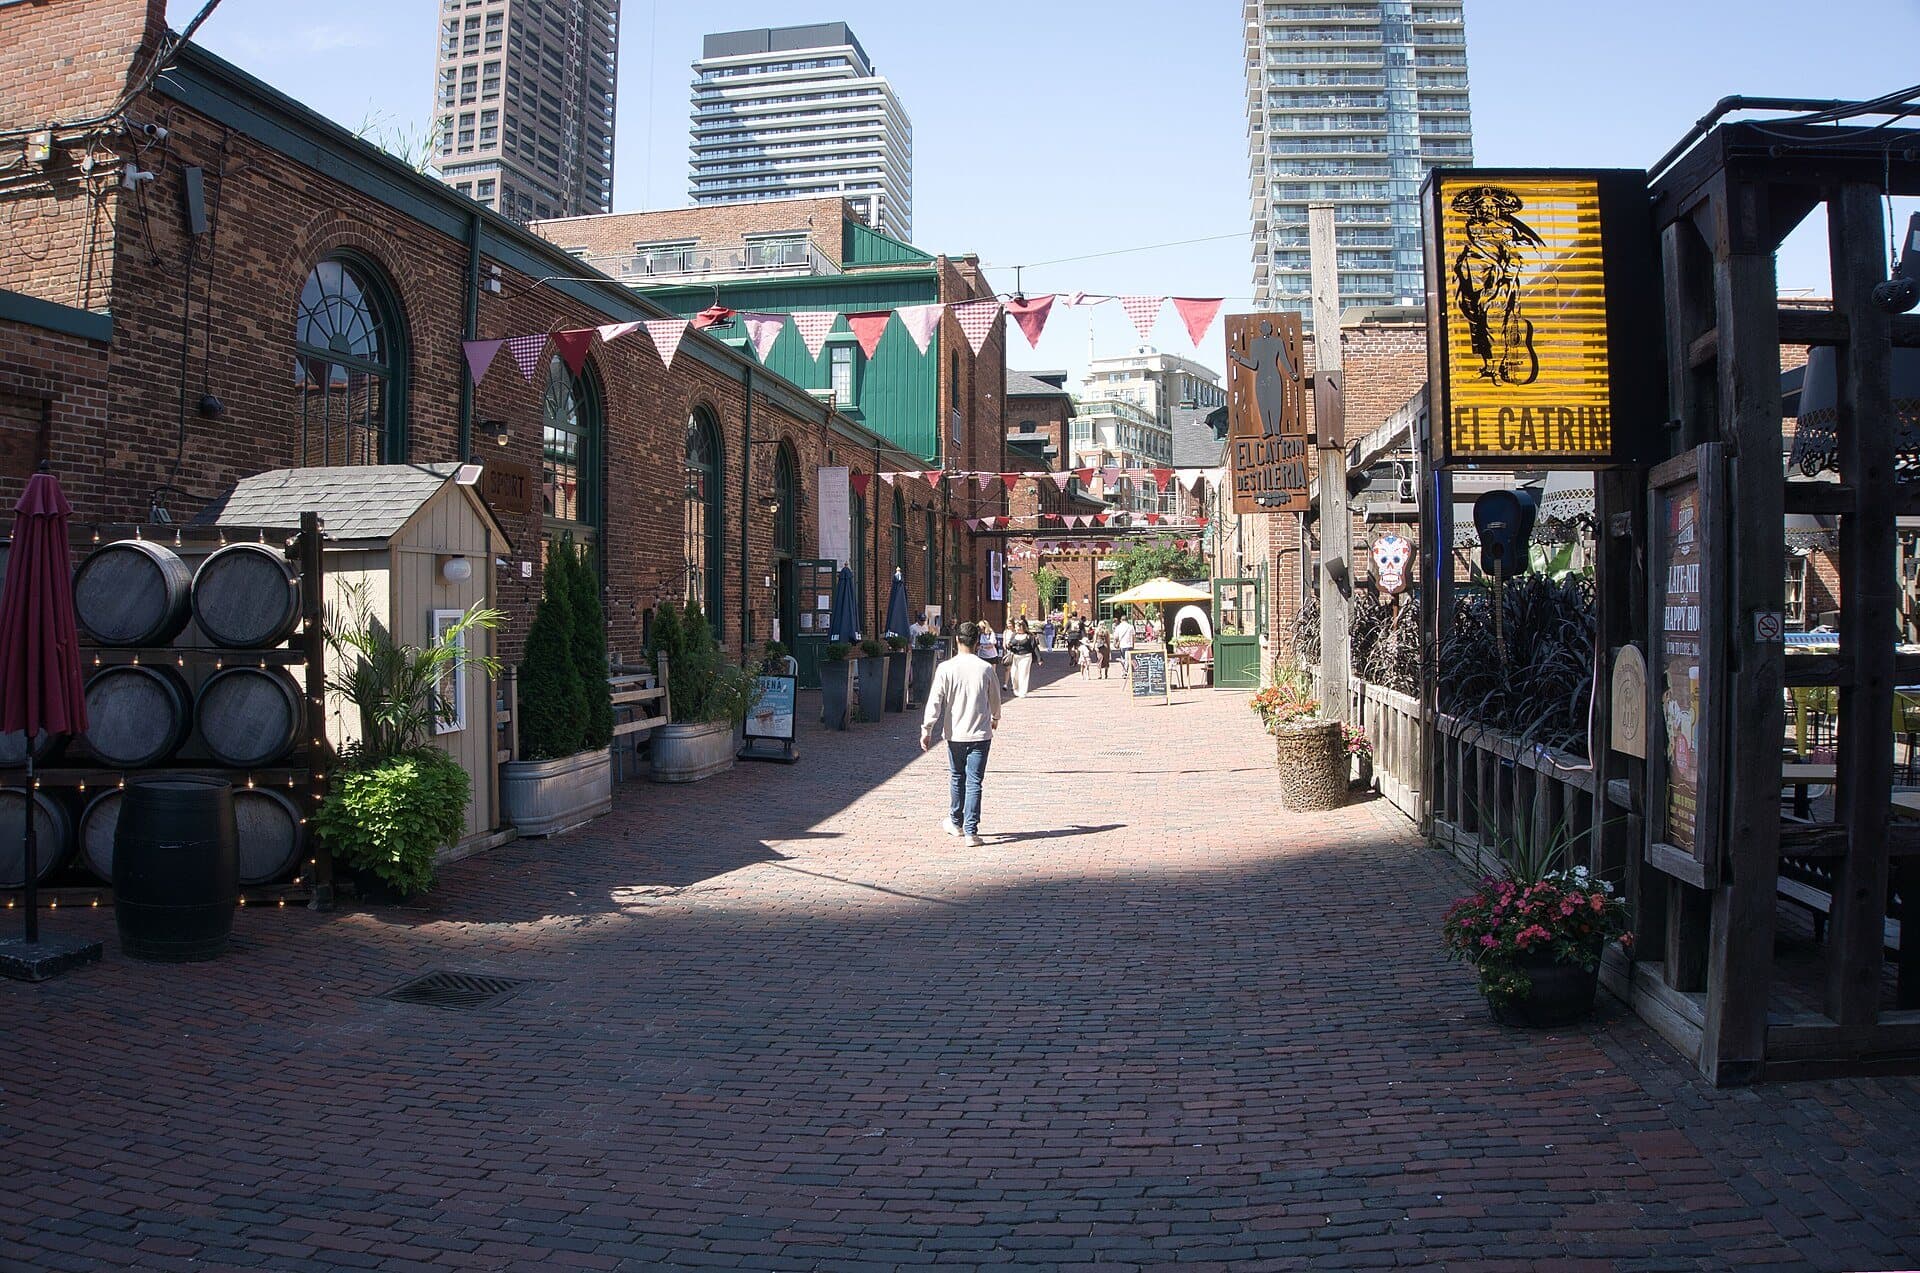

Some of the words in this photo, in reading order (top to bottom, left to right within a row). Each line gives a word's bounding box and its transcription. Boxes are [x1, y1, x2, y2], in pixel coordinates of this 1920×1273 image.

[1455, 407, 1488, 451] EL
[1498, 407, 1608, 451] CATRIN
[1236, 442, 1255, 471] EL
[1255, 439, 1305, 466] CATRIN
[1664, 606, 1687, 631] HAPPY
